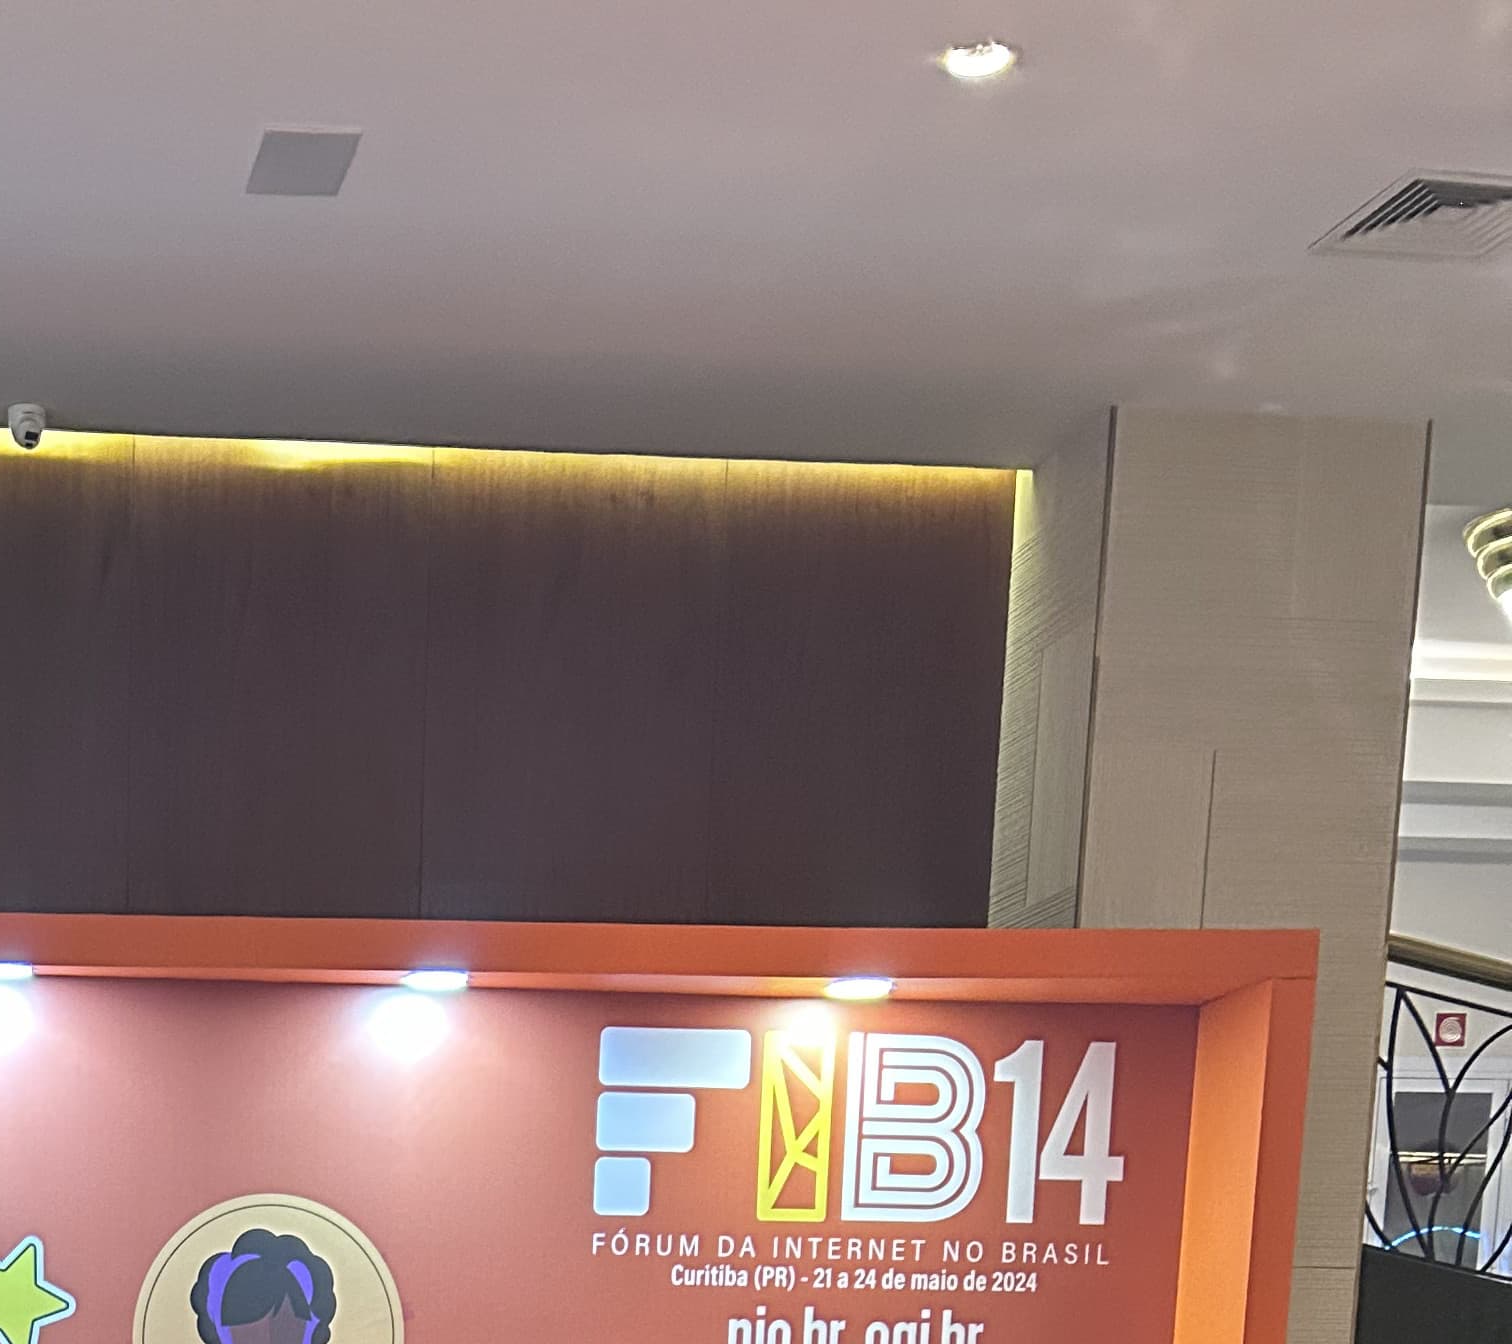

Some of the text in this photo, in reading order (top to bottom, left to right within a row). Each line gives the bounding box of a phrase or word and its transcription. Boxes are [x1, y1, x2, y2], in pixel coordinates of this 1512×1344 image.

[591, 1228, 1112, 1266] FÓRUM DA INTERNET NO BRASIL
[670, 1264, 748, 1288] Curitiba
[754, 1266, 795, 1291] (PR)
[812, 1268, 833, 1289] 21
[836, 1273, 849, 1290] a
[853, 1269, 877, 1290] 24
[881, 1270, 906, 1290] de
[911, 1271, 959, 1292] maio
[963, 1272, 988, 1292] de
[991, 1273, 1038, 1294] 2024
